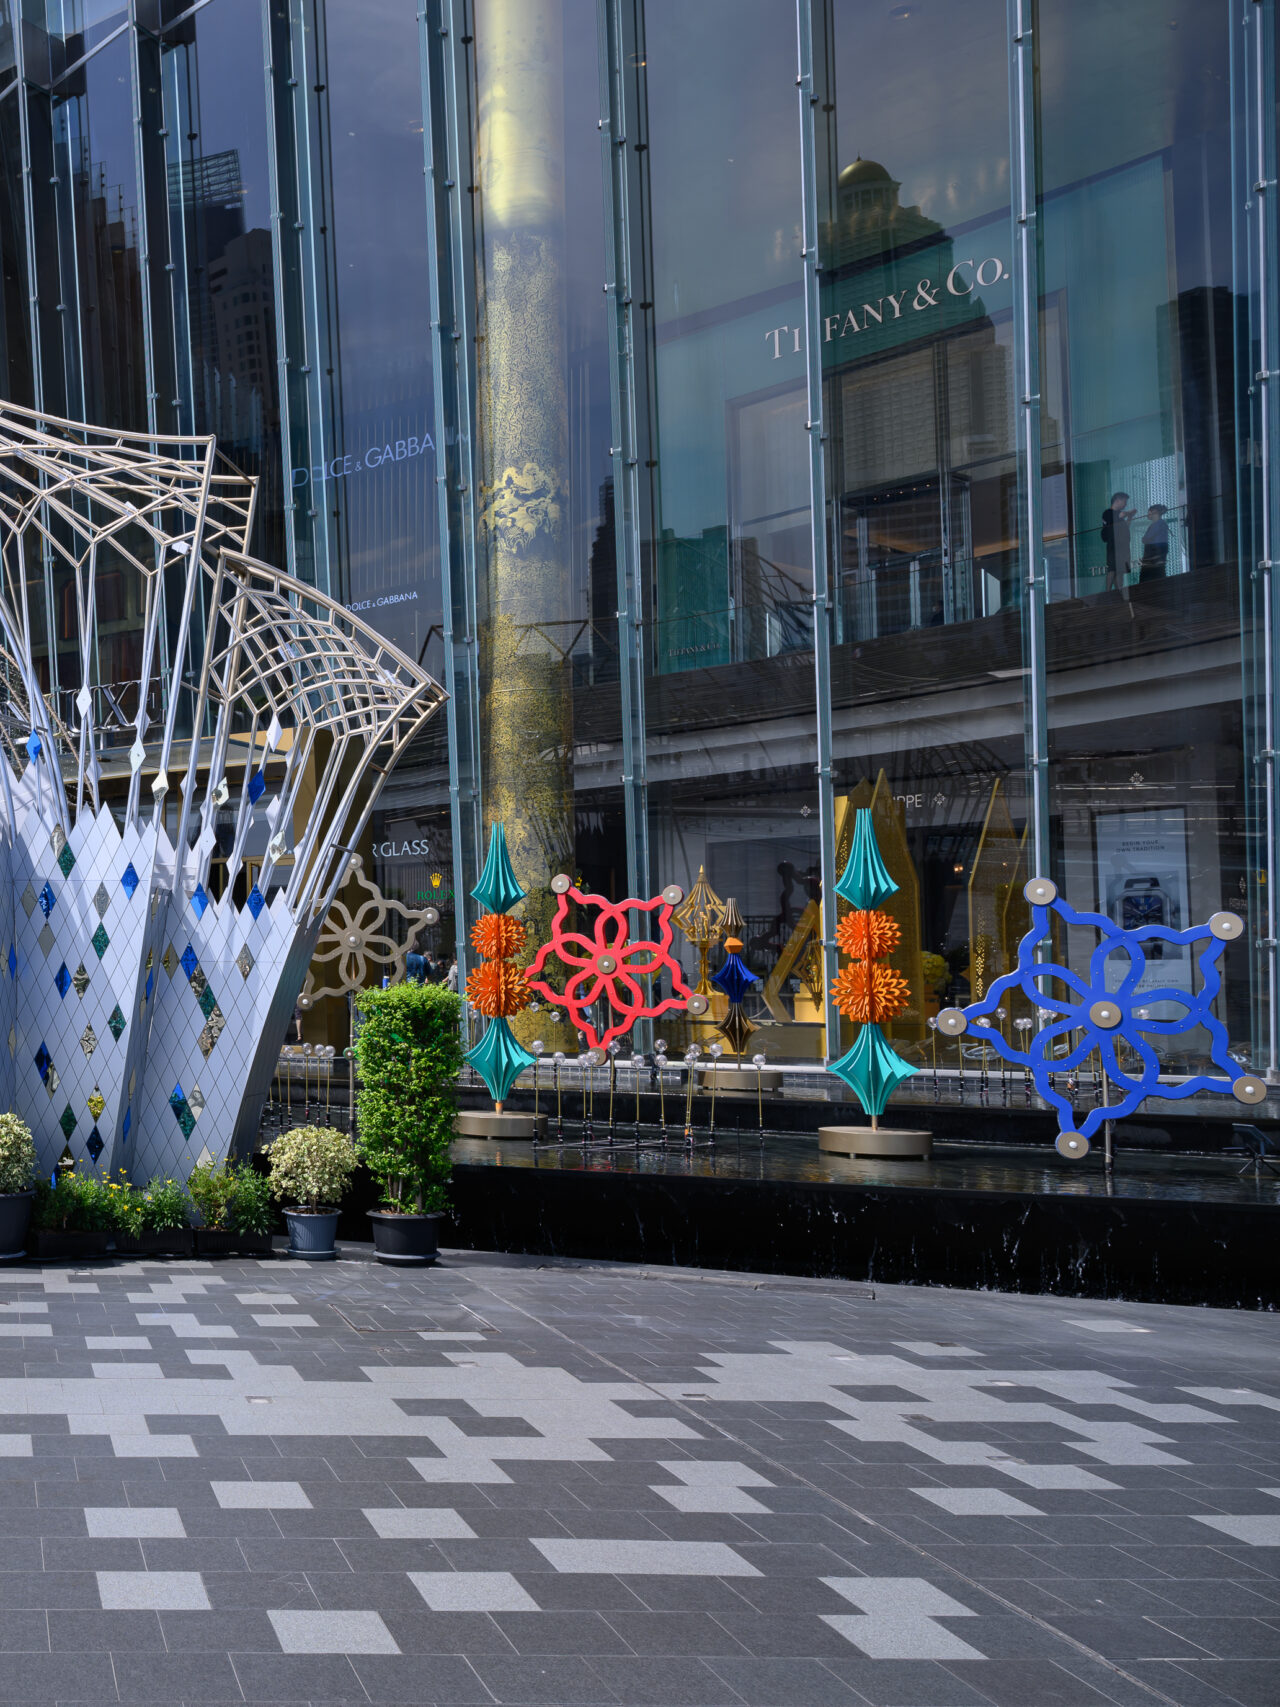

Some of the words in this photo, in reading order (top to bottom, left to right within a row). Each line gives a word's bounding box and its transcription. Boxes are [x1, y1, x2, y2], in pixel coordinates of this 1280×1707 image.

[765, 289, 908, 361] TIFANY
[292, 455, 352, 488] DOLCE
[354, 461, 362, 472] &
[345, 600, 371, 612] DOLCE
[377, 591, 418, 607] GABBANA
[380, 839, 429, 857] GLASS
[417, 888, 456, 901] ROLEX
